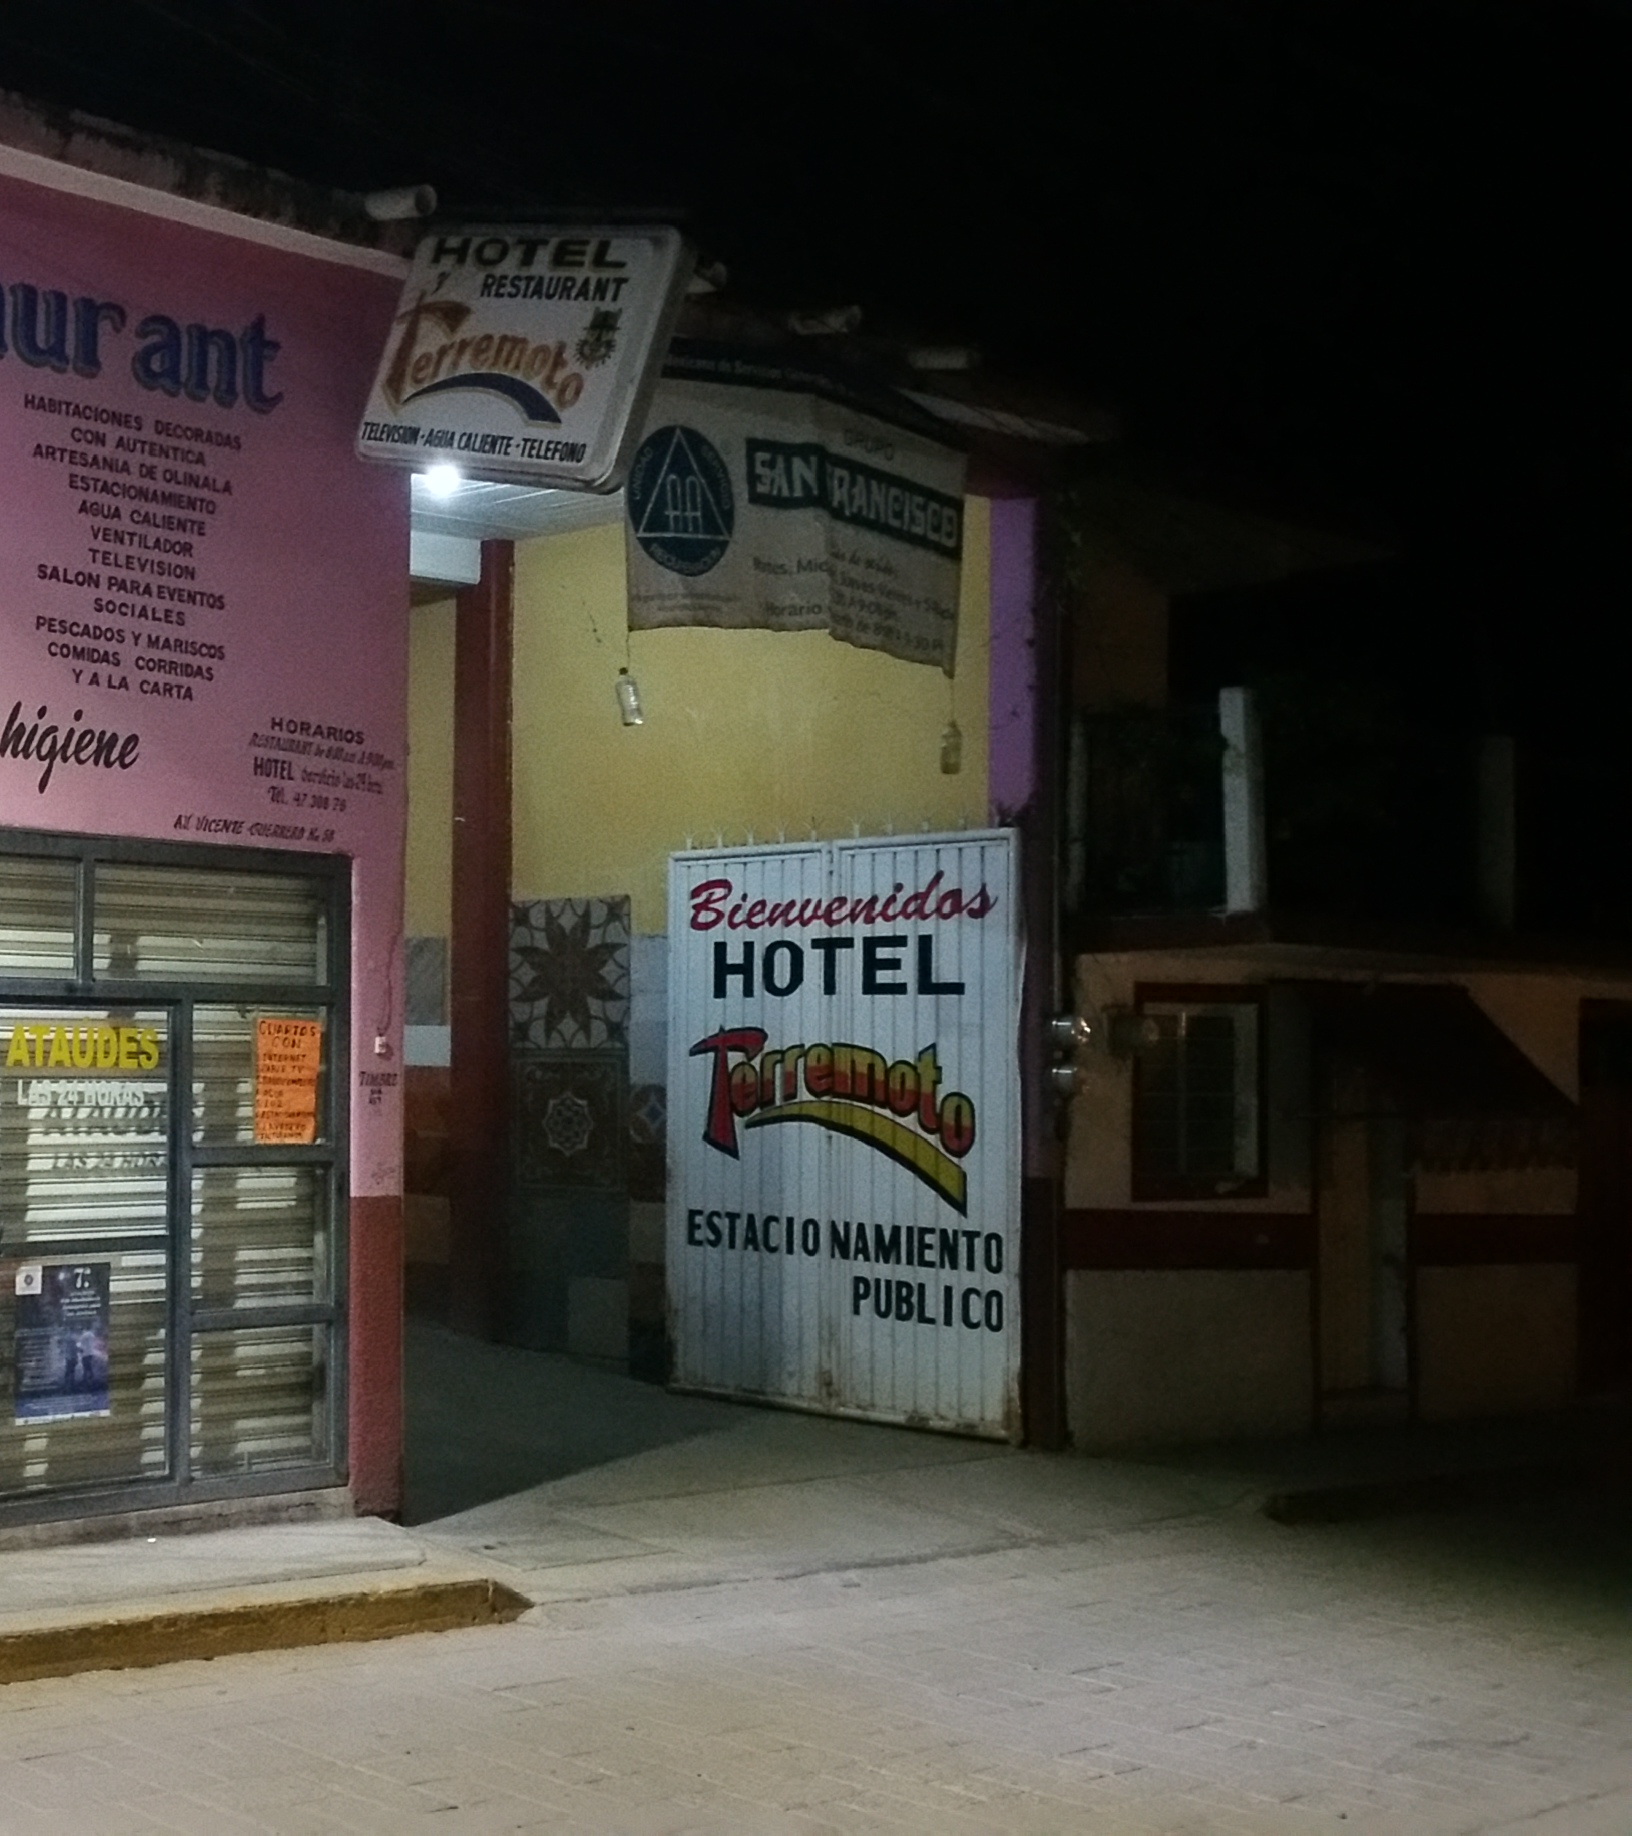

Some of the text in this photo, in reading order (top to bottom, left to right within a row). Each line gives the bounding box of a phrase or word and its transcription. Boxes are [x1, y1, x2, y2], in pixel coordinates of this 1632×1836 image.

[431, 237, 628, 269] HOTEL
[479, 273, 629, 302] RESTAURANT
[382, 291, 584, 416] Terremoto
[23, 393, 243, 451] HABITACIONES DECORADAS
[361, 421, 420, 446] TELEVISION
[457, 432, 513, 456] CALIENTE
[71, 427, 206, 466] CON AUTENTICA
[32, 443, 233, 495] ARTESANIA DE OLINALA
[69, 473, 216, 515] ESTACIONAMIENTO
[754, 452, 958, 548] SAN RANCISCO
[78, 500, 206, 537] AGUA CALIENTE
[91, 525, 193, 558] VENTILADOR
[88, 548, 196, 581] TELEVISION
[37, 564, 225, 611] SALON PARA EVENTOS
[93, 597, 186, 626] SOCIALES
[35, 615, 225, 660] PESCADOS Y MARISCOS
[47, 642, 215, 682] COMIDAS CORRIDAS
[72, 668, 194, 701] Y A LA CARTA
[270, 716, 365, 745] HORARIOS
[253, 756, 294, 781] HOTEL
[196, 815, 245, 836] VICENTE
[689, 870, 998, 931] Bienvenidos
[713, 934, 965, 999] HOTEL
[259, 1020, 317, 1037] CUARTOS
[271, 1036, 301, 1049] CON
[18, 1079, 145, 1107] LAS 24 HORAS
[689, 1025, 975, 1160] Terremoto
[852, 1276, 1003, 1332] PUBLICO
